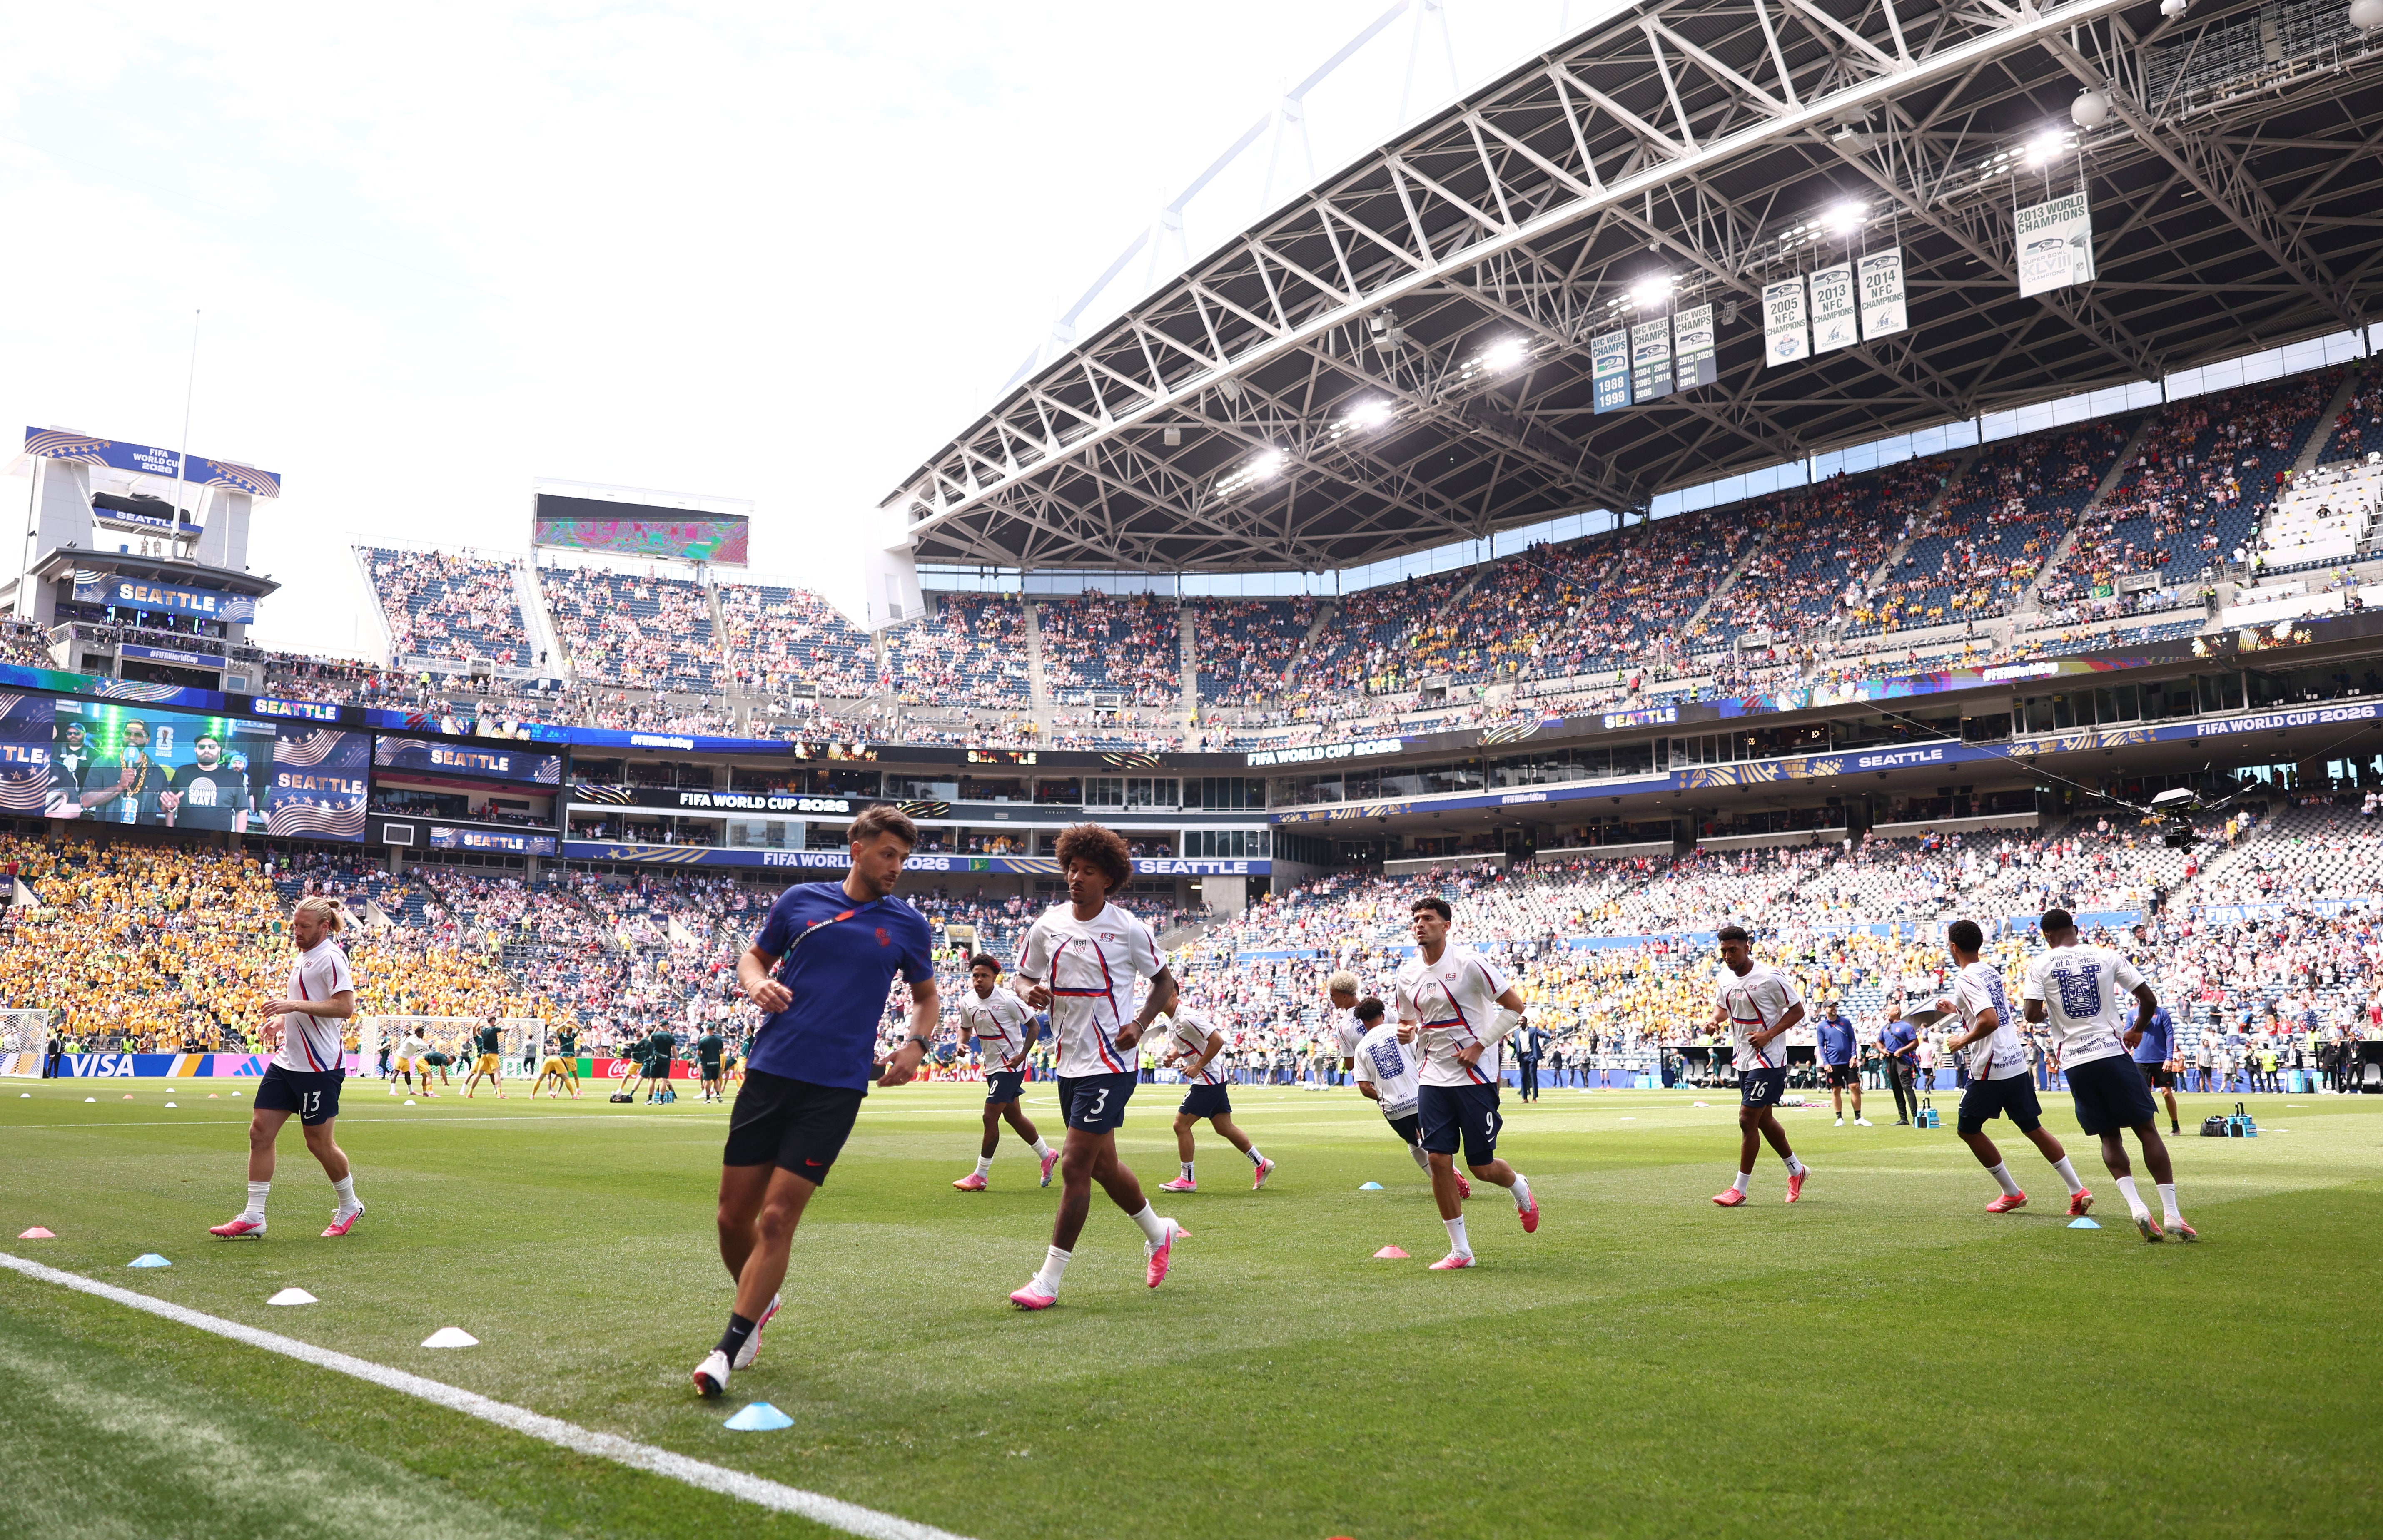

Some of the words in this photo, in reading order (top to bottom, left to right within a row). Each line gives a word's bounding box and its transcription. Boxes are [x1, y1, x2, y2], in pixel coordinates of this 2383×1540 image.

[2017, 207, 2044, 224] 2013
[2046, 195, 2083, 214] WORLD
[2018, 206, 2084, 234] CHAMPIONS
[2021, 254, 2071, 279] XLVIII
[2023, 256, 2045, 266] SUPER
[1866, 270, 1895, 289] 2014
[2027, 269, 2066, 283] CHAMPIONS
[1817, 284, 1845, 303] 2013
[1871, 284, 1892, 298] NFC
[1770, 298, 1797, 315] 2005
[1822, 299, 1842, 312] NFC
[1862, 292, 1903, 310] CHAMPIONS
[1676, 313, 1689, 324] NFC
[1691, 306, 1711, 318] WEST
[1775, 311, 1795, 325] NFC
[1813, 306, 1853, 324] CHAMPIONS
[1633, 326, 1646, 336] NFC
[1649, 319, 1668, 331] WEST
[1676, 315, 1711, 333] CHAMPS
[1766, 319, 1805, 336] CHAMPIONS
[1593, 338, 1604, 348] AFC
[1606, 332, 1625, 343] WEST
[1634, 328, 1668, 346] CHAMPS
[1593, 341, 1626, 357] CHAMPS
[1678, 355, 1694, 366] 2013
[1697, 349, 1713, 361] 2020
[1635, 367, 1651, 378] 2004
[1654, 362, 1670, 373] 2007
[1679, 366, 1695, 376] 2014
[1599, 376, 1624, 393] 1988
[1635, 377, 1651, 388] 2005
[1655, 372, 1671, 383] 2010
[1680, 376, 1695, 387] 2016
[1600, 391, 1625, 407] 1999
[1636, 388, 1652, 399] 2006
[133, 453, 165, 465] WORLD
[150, 448, 168, 458] FIFA
[142, 462, 172, 474] 2026
[2125, 575, 2155, 587] 334
[119, 583, 215, 612] SEATTLE
[1743, 633, 1768, 643] 332
[150, 650, 198, 664] #FIFAWorldCup
[1982, 662, 2059, 682] #FIFAWorldCup
[255, 699, 336, 720] SEATTLE
[1605, 708, 1676, 729] SEATTLE
[2197, 722, 2228, 736] FIFA
[2229, 716, 2285, 732] WORLD
[2286, 712, 2317, 726] CUP
[2319, 706, 2376, 723] 2026
[631, 734, 693, 750] #FIFAWorldCup
[0, 745, 44, 764] TLE
[431, 749, 509, 771] SEATTLE
[1247, 751, 1276, 766] FIFA
[1276, 747, 1325, 764] WORLD
[1325, 744, 1353, 759] CUP
[1353, 739, 1402, 756] 2026
[1859, 749, 1943, 768] SEATTLE
[278, 773, 363, 794] SEATTLE
[189, 797, 216, 806] WAVE
[680, 793, 711, 807] FIFA
[712, 794, 766, 809] WORLD
[768, 797, 798, 810] CUP
[798, 799, 850, 813] 2026
[1502, 793, 1547, 804] #FIFAWorldCup
[464, 834, 524, 850] SEATTLE
[763, 853, 798, 866] FIFA
[1139, 861, 1248, 874] SEATTLE
[2205, 906, 2242, 921] FIFA
[806, 923, 823, 933] WORLD
[2049, 953, 2072, 962] United
[2065, 957, 2095, 967] America
[1372, 1031, 1393, 1044] America
[1378, 1026, 1395, 1036] States
[2087, 1037, 2106, 1046] States
[2061, 1051, 2076, 1061] Men's
[2077, 1043, 2102, 1057] National
[2103, 1040, 2119, 1048] Team
[64, 1054, 135, 1077] VISA
[990, 1080, 998, 1094] 8
[1750, 1081, 1768, 1097] 16
[303, 1091, 321, 1112] 13
[1090, 1088, 1109, 1114] 3
[1390, 1102, 1405, 1110] United
[1486, 1112, 1493, 1135] 9
